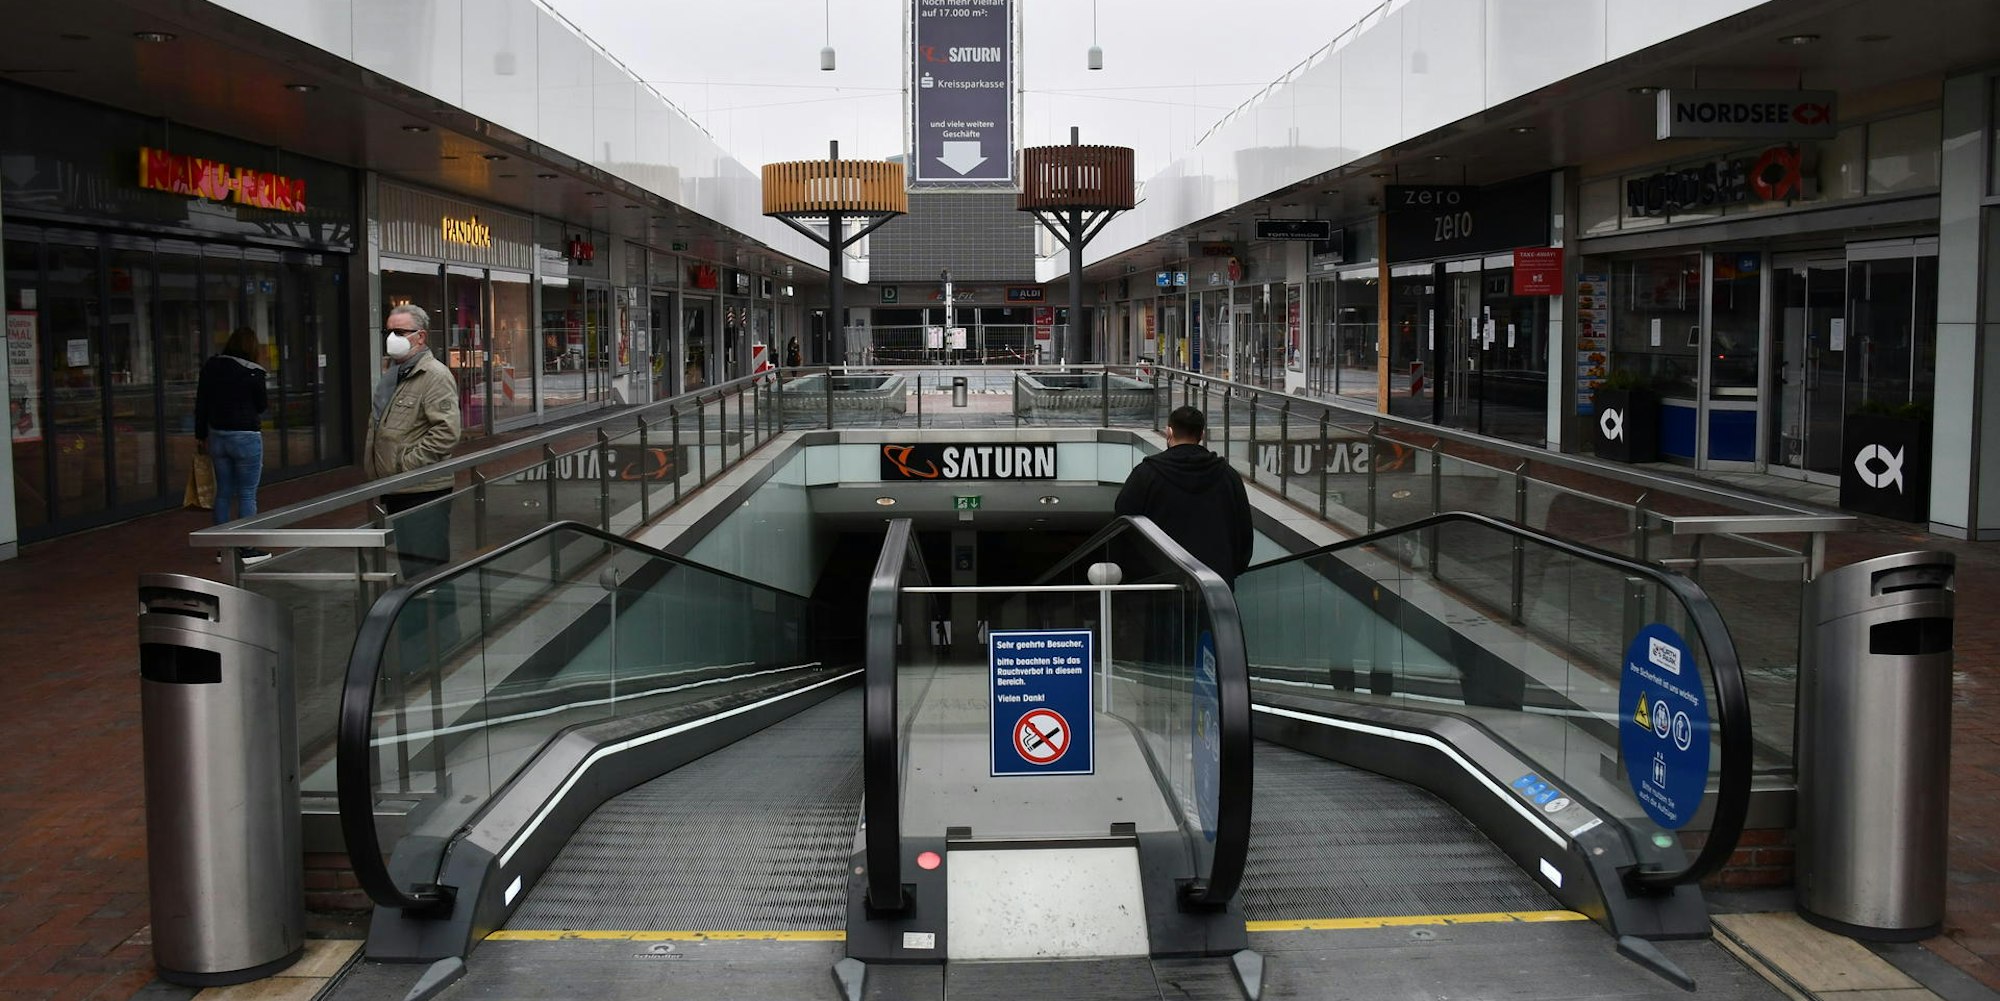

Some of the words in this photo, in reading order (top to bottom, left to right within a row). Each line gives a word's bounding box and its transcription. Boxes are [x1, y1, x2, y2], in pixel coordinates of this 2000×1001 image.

[922, 8, 936, 17] auf
[939, 9, 970, 17] 17.000
[949, 47, 1001, 63] SATURN
[938, 79, 1005, 89] Kreissparkasse
[1676, 102, 1789, 124] NORDSEE
[943, 130, 981, 138] Geschäfte
[1404, 190, 1461, 205] zero
[1434, 211, 1473, 242] zero
[443, 216, 492, 248] PANDORA
[884, 287, 895, 299] D
[1019, 289, 1041, 298] ALDI
[942, 446, 1055, 478] SATURN
[997, 641, 1014, 649] Sehr
[1016, 641, 1045, 650] geehrte
[1047, 640, 1084, 649] Besucher,
[997, 658, 1014, 666] bitte
[1016, 657, 1050, 666] beachten
[1052, 657, 1065, 665] Sie
[1067, 657, 1081, 665] das
[997, 667, 1044, 676] Rauchverbot
[1046, 667, 1053, 675] in
[1055, 667, 1082, 675] diesem
[997, 678, 1026, 686] Bereich.
[997, 694, 1021, 702] Vielen
[1023, 694, 1045, 702] Dank!
